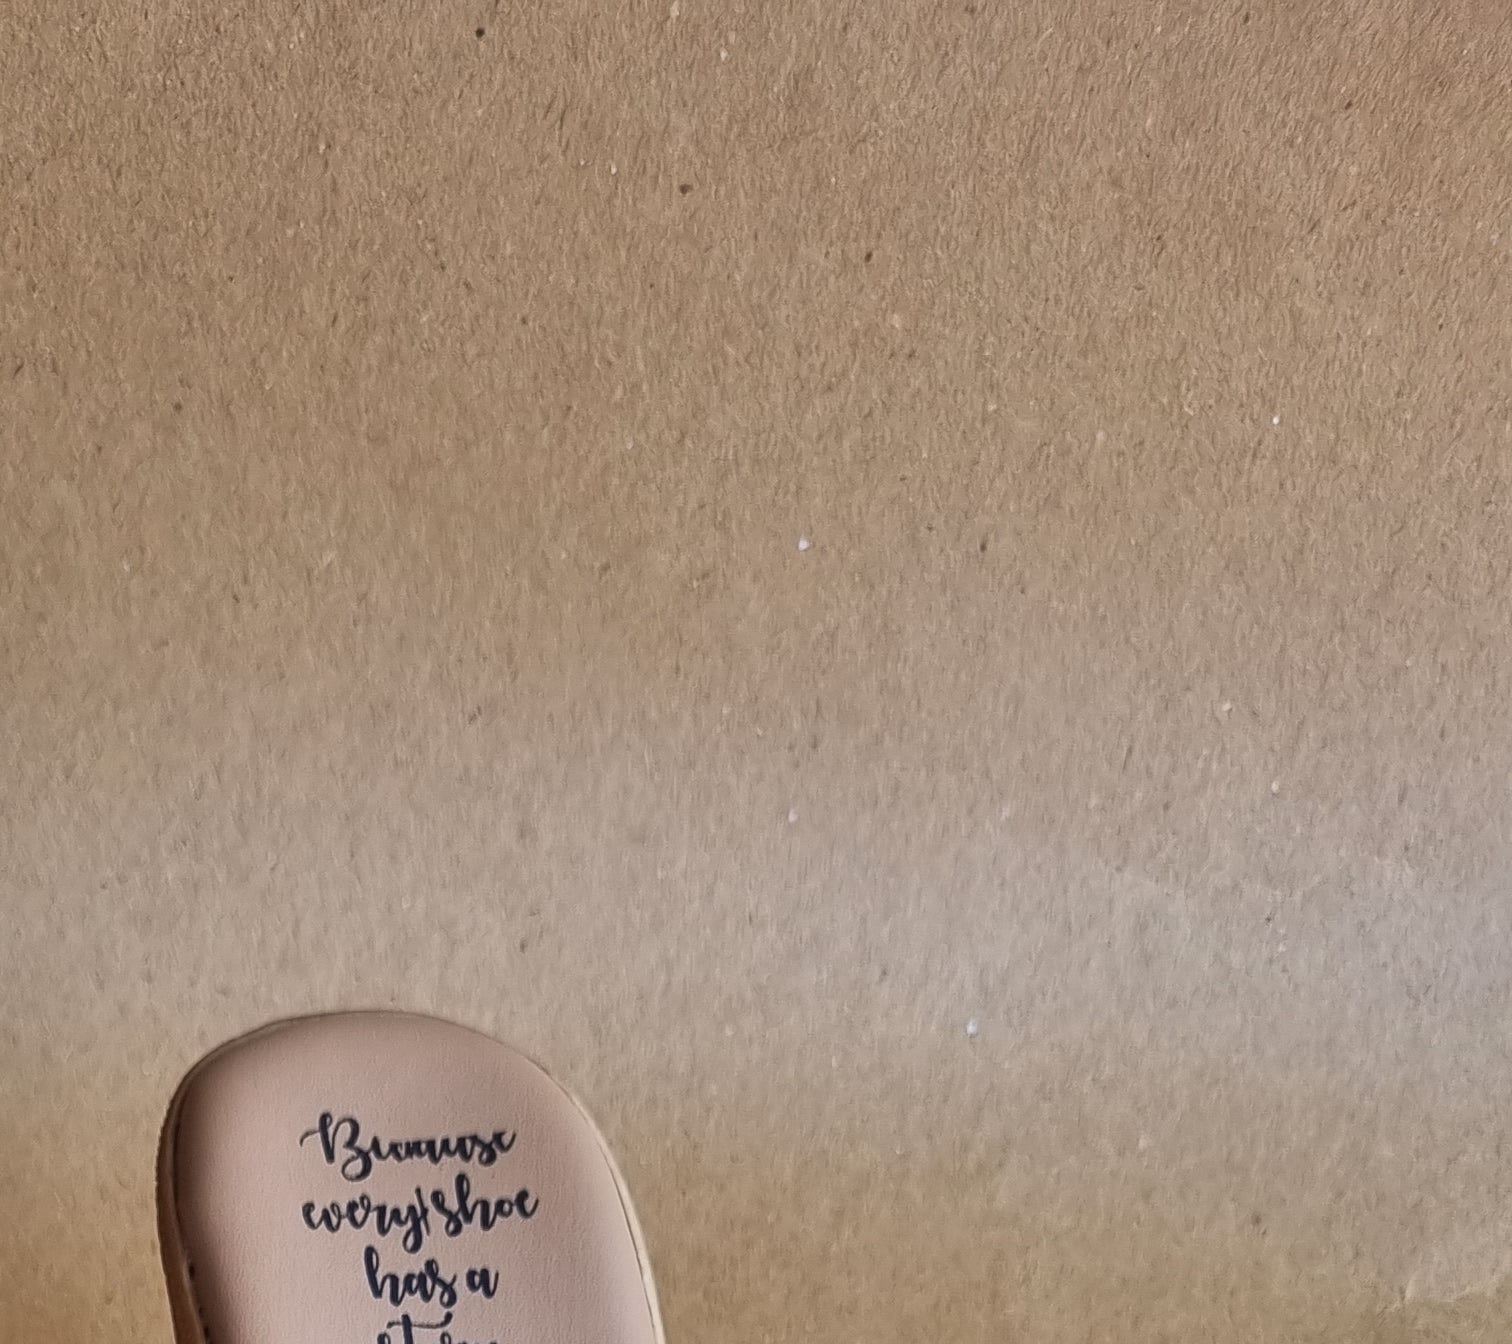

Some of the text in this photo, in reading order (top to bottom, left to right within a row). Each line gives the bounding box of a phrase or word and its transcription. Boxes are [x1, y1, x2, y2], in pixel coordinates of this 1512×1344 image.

[299, 1112, 517, 1182] Because
[430, 1173, 539, 1238] shoe
[364, 1245, 499, 1309] has a
